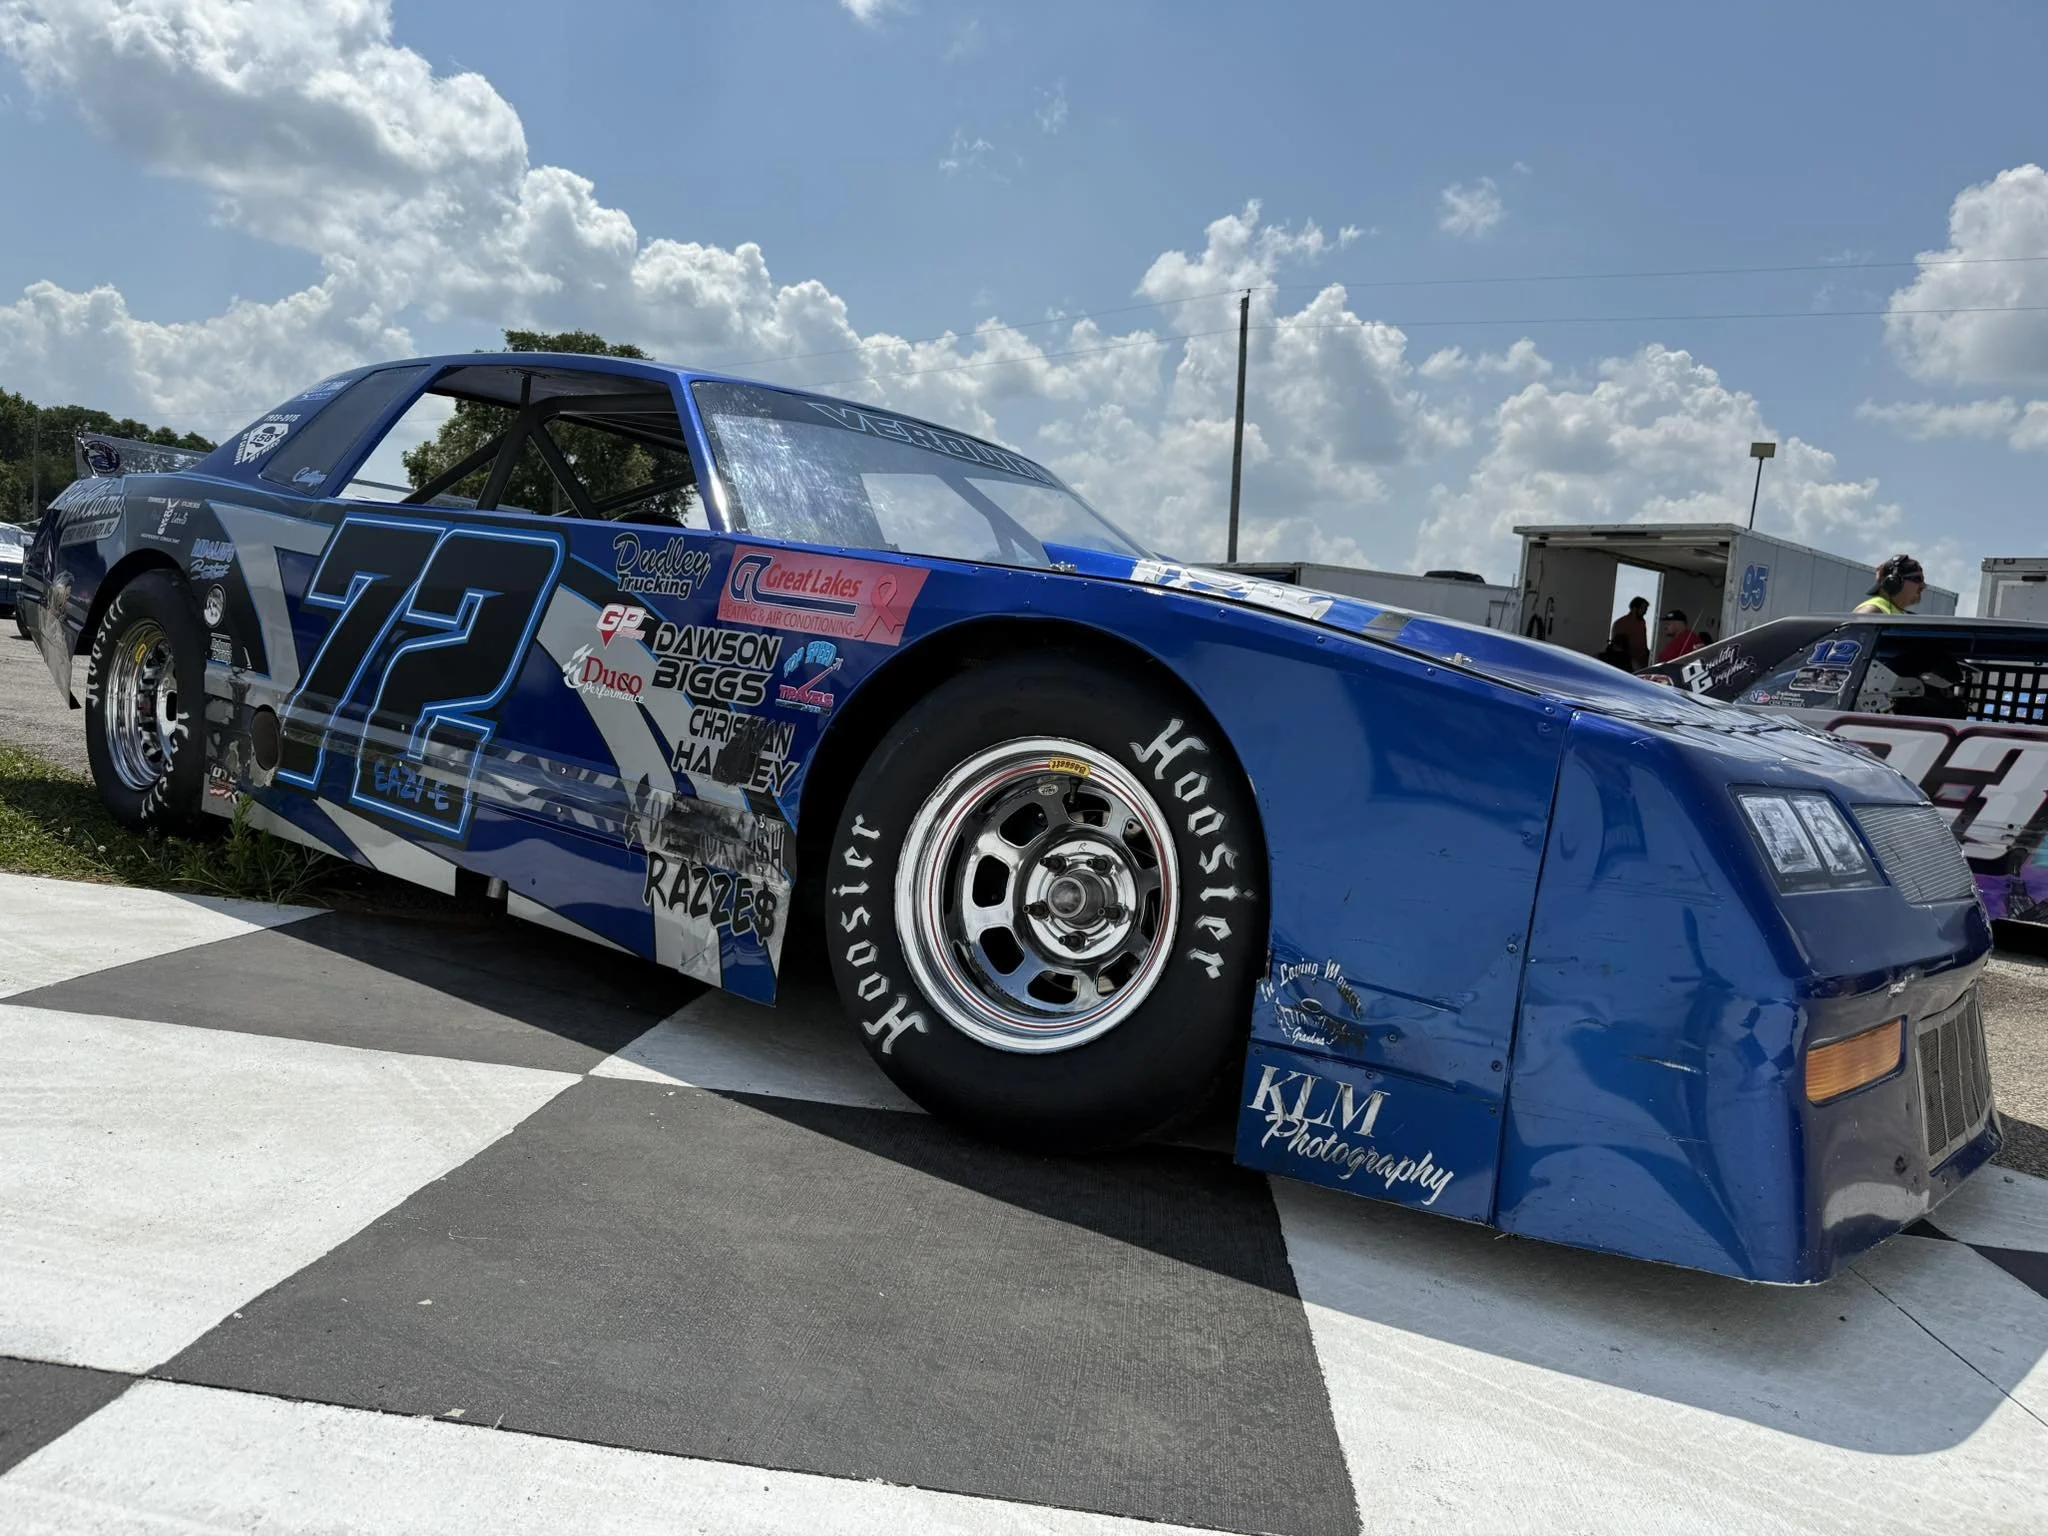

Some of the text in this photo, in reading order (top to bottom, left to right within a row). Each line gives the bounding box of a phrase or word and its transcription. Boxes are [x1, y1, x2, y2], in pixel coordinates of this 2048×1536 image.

[613, 531, 711, 590] Dudley
[765, 563, 863, 598] Great Lakes
[617, 571, 693, 600] Trucking
[1741, 564, 1769, 611] 95
[596, 603, 648, 633] GP
[721, 602, 856, 636] HEATING & AIR CONDITIONING
[653, 622, 784, 672] DAWSON
[1806, 639, 1862, 667] 12
[276, 512, 566, 841] 72
[583, 656, 644, 695] Duco
[583, 681, 645, 704] Performance
[651, 657, 774, 707] BIGGS
[671, 739, 801, 798] HAEY
[1052, 760, 1087, 775] Bassett
[1130, 718, 1255, 980] Hoosier
[832, 813, 929, 1055] Hoosier
[1260, 981, 1276, 1002] In
[1280, 957, 1319, 987] Loving
[1246, 1063, 1391, 1138] KLM
[1260, 1111, 1455, 1206] Photography
